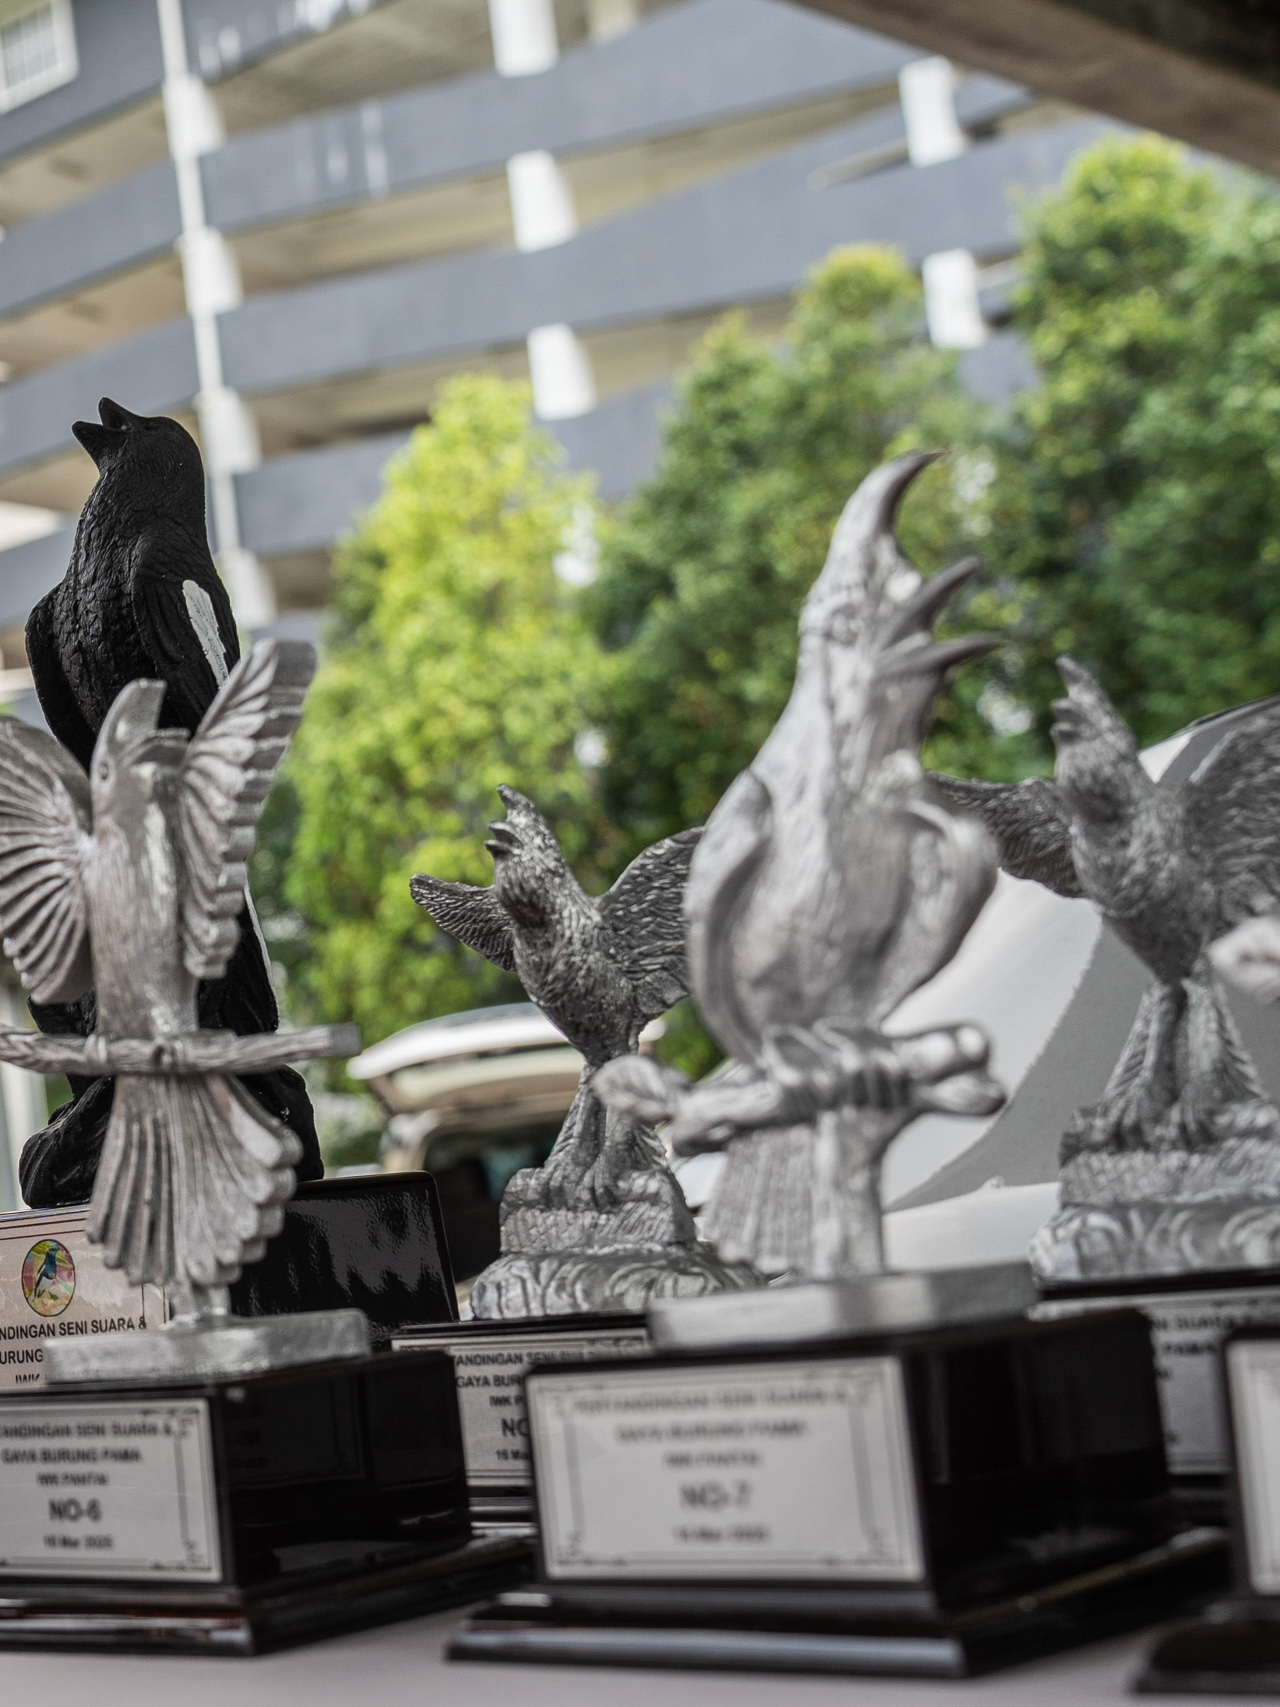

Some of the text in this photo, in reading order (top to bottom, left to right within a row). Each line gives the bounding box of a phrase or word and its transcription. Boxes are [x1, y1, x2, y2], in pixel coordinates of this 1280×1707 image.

[59, 1321, 88, 1336] SENI
[91, 1317, 135, 1333] SUARA
[138, 1316, 147, 1330] &
[456, 1375, 521, 1388] GAYA BUR
[490, 1395, 512, 1406] IWK
[679, 1479, 751, 1512] NO-7
[48, 1498, 102, 1522] NO-6
